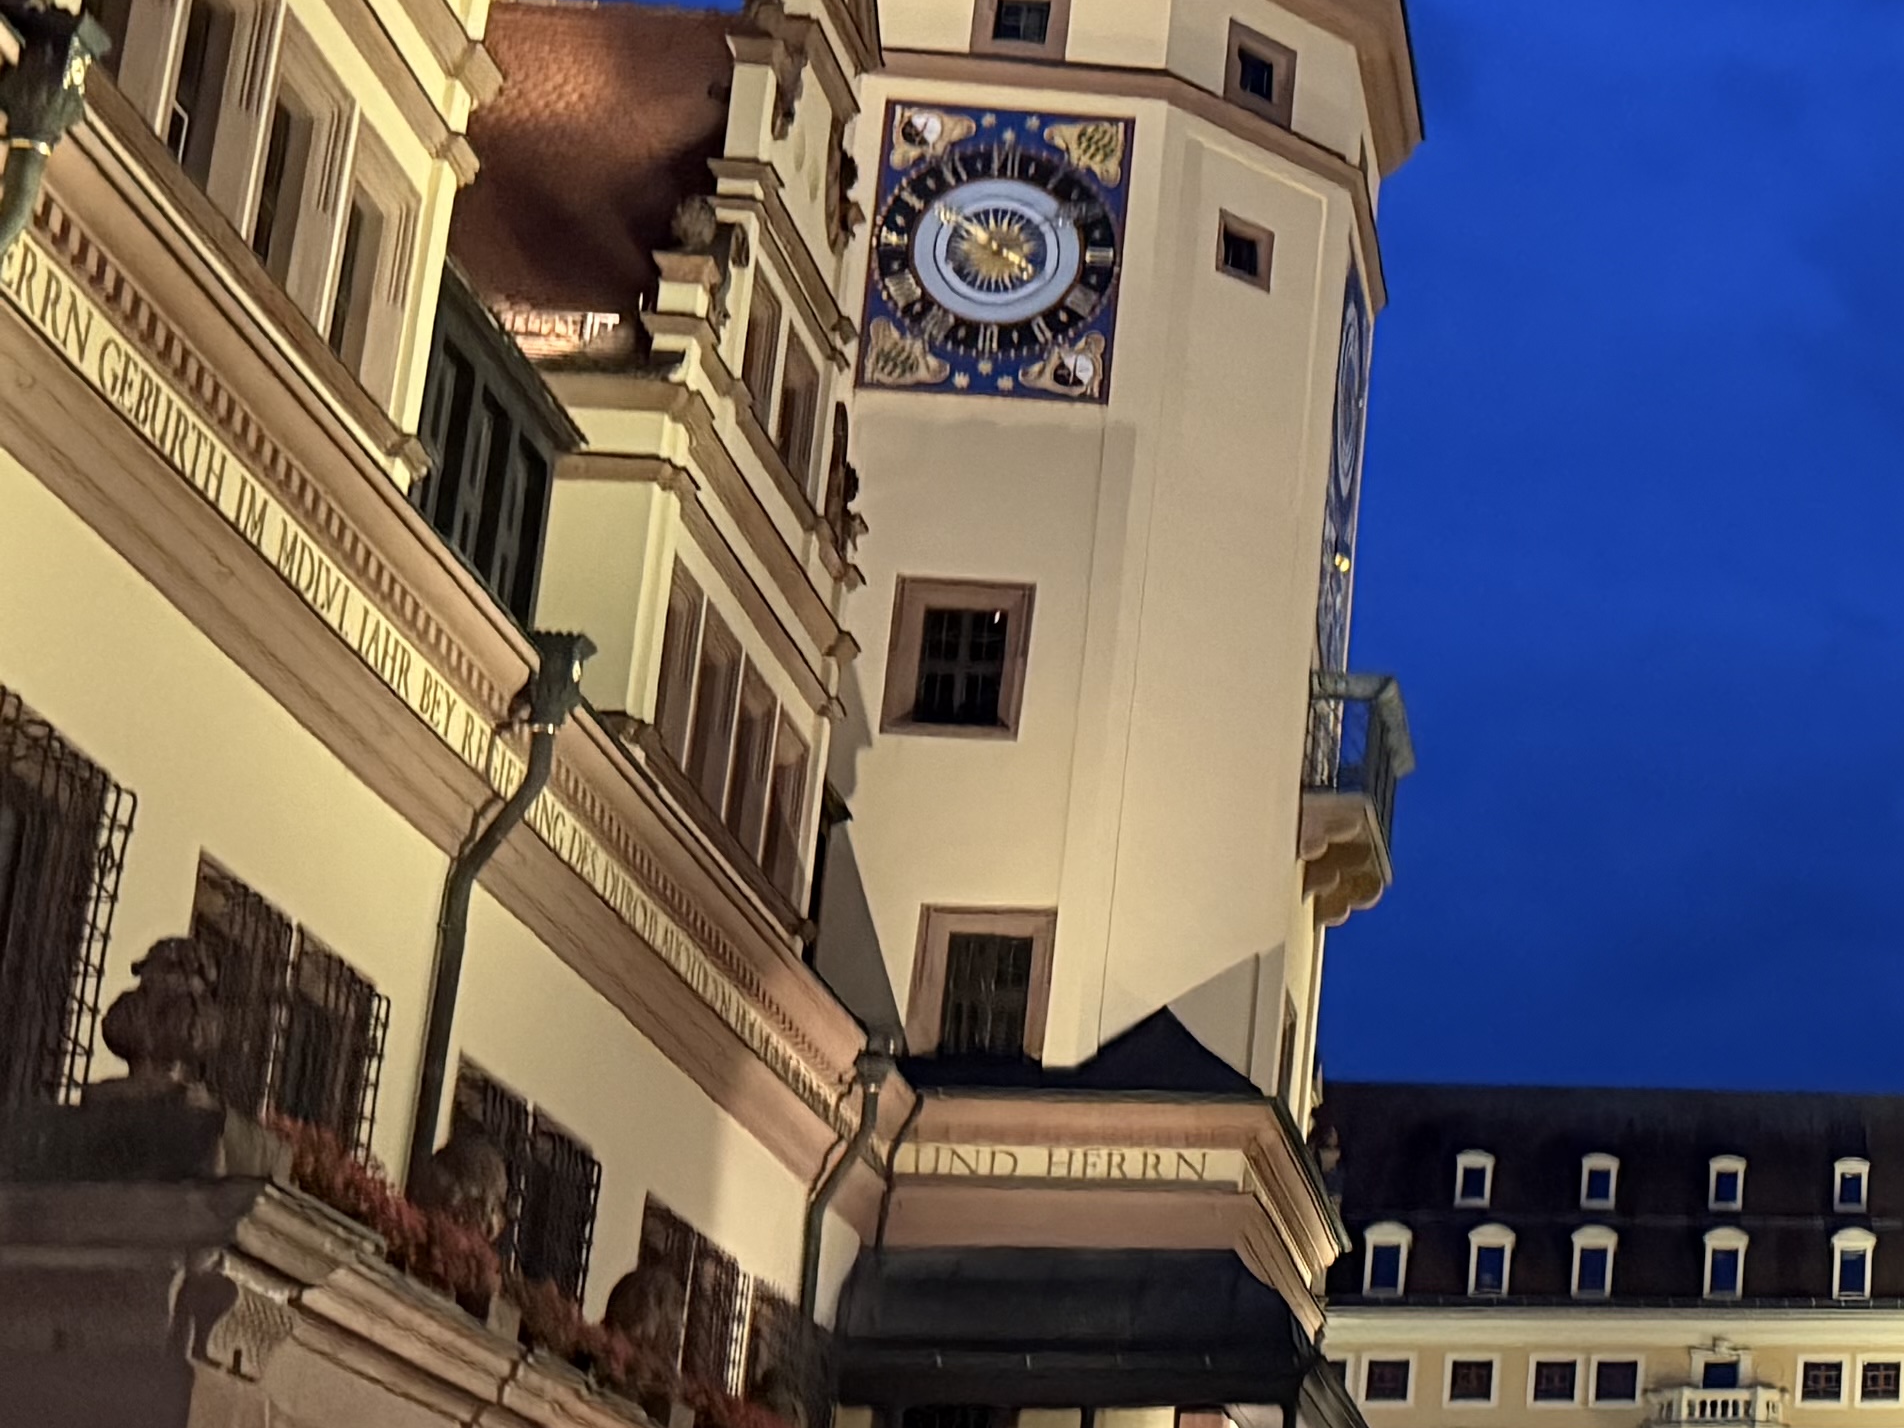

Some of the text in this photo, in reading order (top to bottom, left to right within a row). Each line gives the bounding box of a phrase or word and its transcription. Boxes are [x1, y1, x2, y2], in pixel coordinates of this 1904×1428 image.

[98, 336, 227, 506] GEBURTH
[231, 472, 268, 549] IM
[418, 667, 458, 742] BEY
[914, 1145, 1208, 1181] UND HERRN
